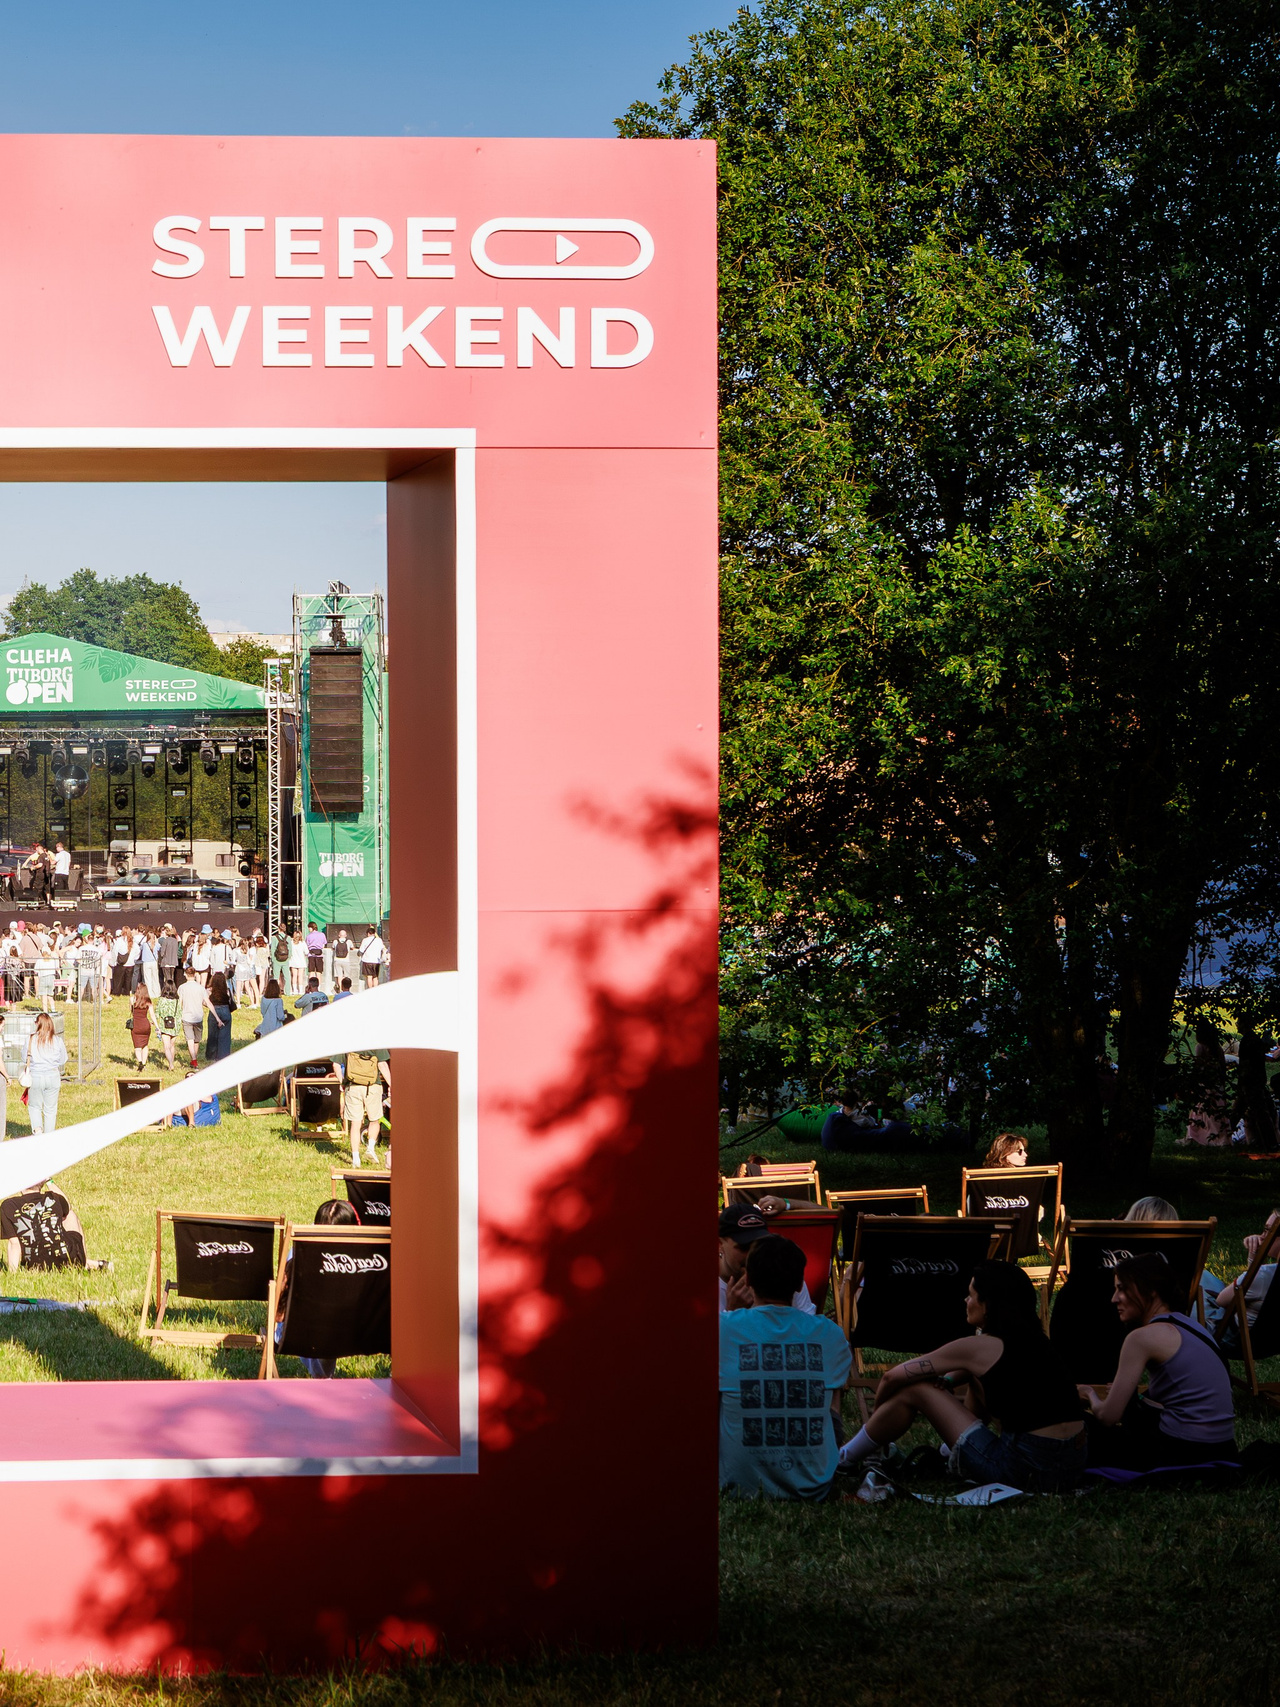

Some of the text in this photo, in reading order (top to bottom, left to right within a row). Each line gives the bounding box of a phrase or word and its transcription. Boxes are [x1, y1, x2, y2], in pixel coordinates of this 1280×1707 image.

[151, 305, 655, 369] WEEKEND
[6, 647, 73, 667] СЦЕНА
[6, 666, 74, 684] TUBORG
[5, 678, 74, 705] OPEN
[125, 691, 198, 702] WEEKEND
[318, 860, 365, 878] OPEN
